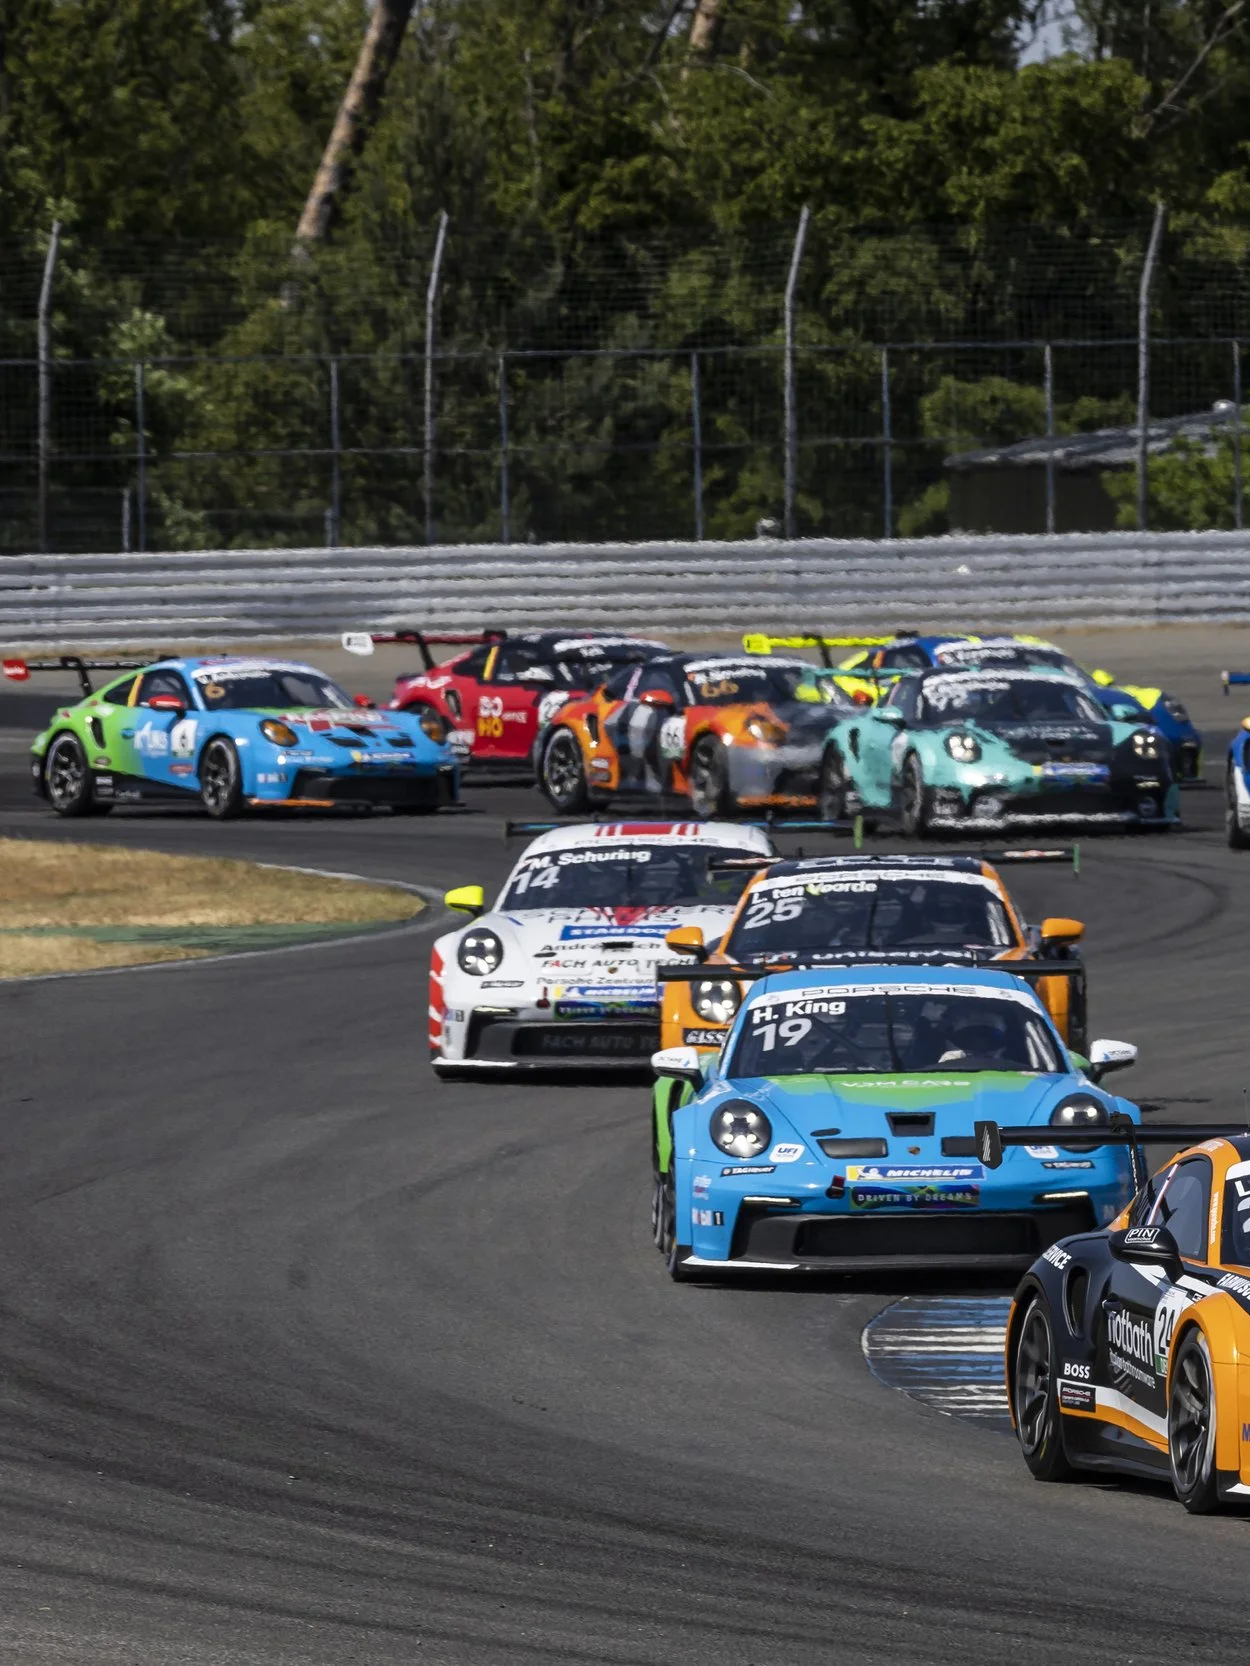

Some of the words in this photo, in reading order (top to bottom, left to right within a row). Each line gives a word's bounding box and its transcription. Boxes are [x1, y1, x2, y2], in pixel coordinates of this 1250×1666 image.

[528, 857, 553, 870] M.
[557, 849, 652, 866] Schuring
[512, 866, 560, 894] 14
[752, 892, 768, 904] L.
[772, 886, 804, 900] ten
[806, 881, 877, 896] Voorde
[743, 897, 807, 929] 25
[542, 959, 586, 968] FACH
[592, 959, 638, 967] AUTO
[802, 985, 977, 997] PORSCHE
[752, 1008, 779, 1024] H.
[785, 1000, 846, 1017] King
[686, 1030, 726, 1044] GASS
[752, 1017, 812, 1051] 19
[887, 1169, 973, 1177] MICHELIN
[858, 1194, 900, 1202] DRIVEN
[907, 1193, 919, 1202] BY
[1129, 1229, 1154, 1238] PIN
[1159, 1306, 1176, 1356] 24
[1064, 1362, 1090, 1379] BOSS
